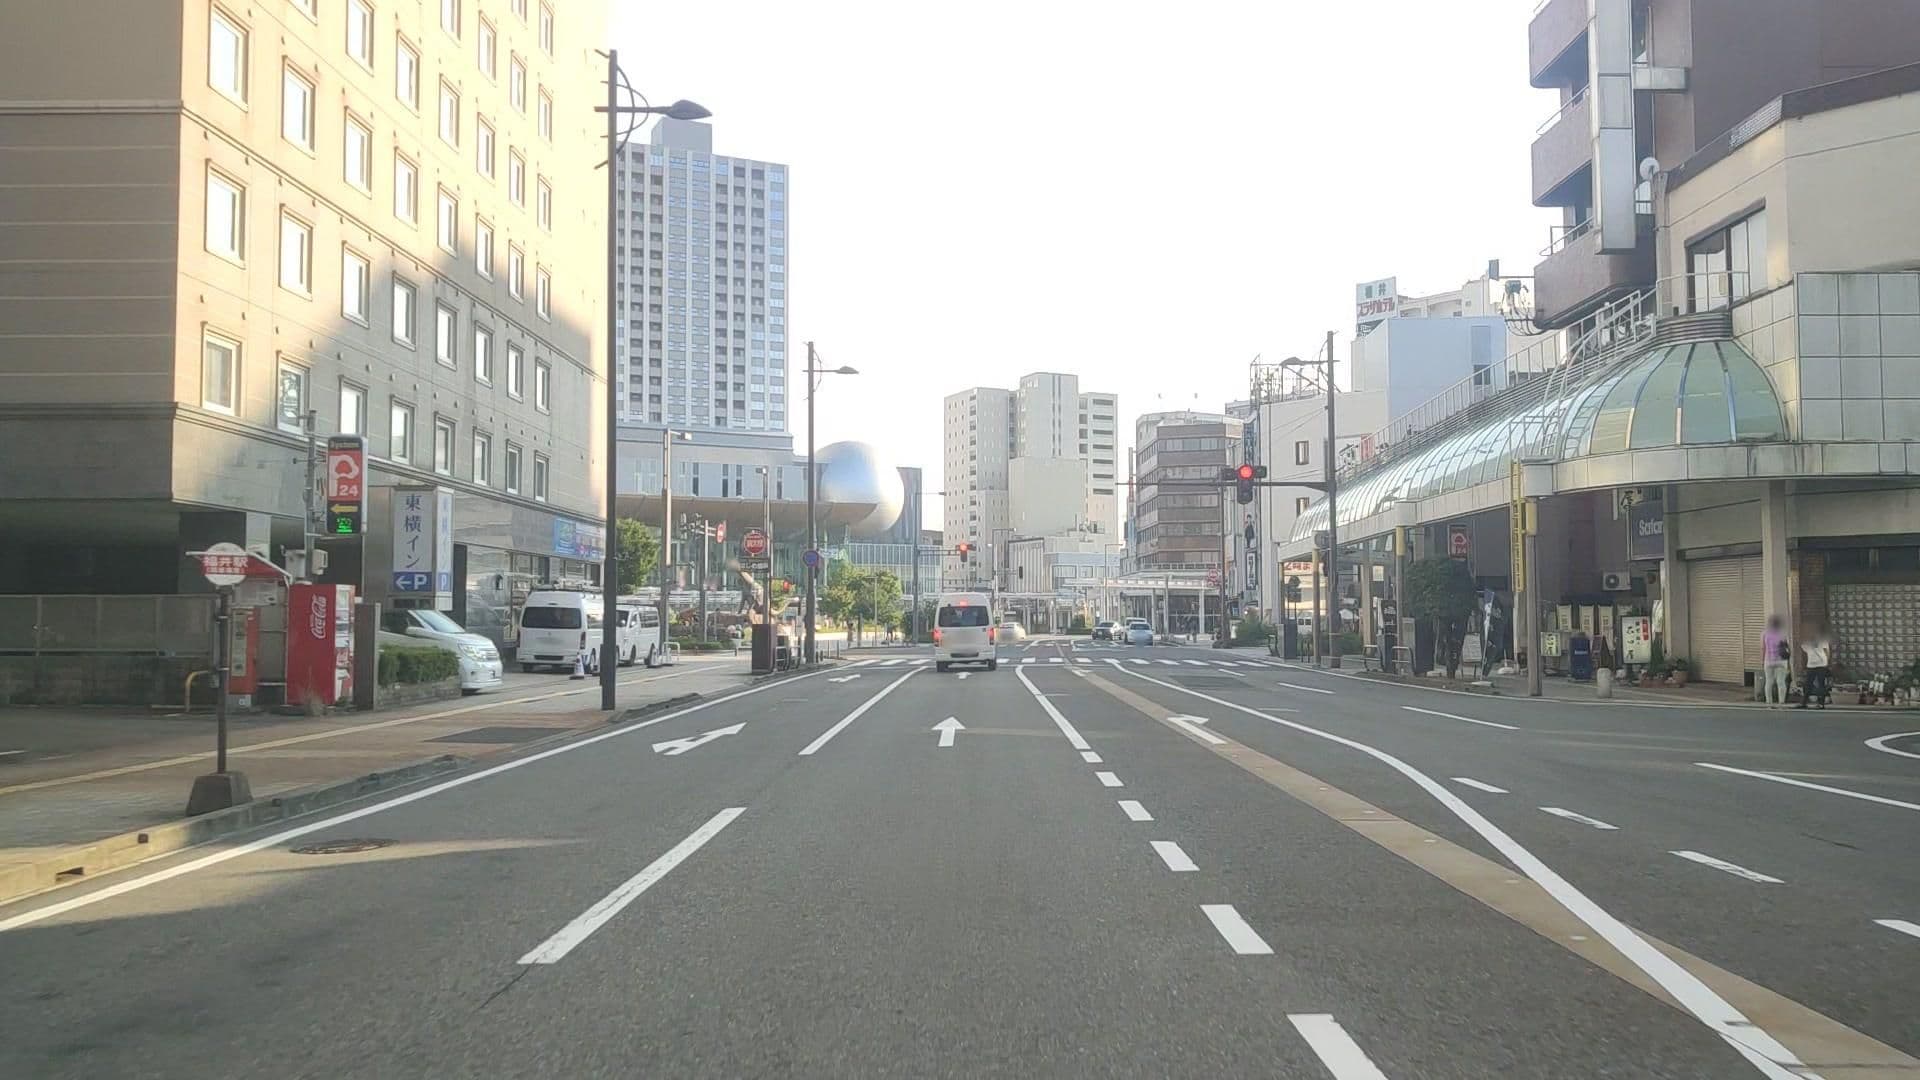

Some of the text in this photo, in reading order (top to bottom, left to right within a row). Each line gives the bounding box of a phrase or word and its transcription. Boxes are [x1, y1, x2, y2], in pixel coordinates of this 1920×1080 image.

[339, 484, 359, 496] 24
[405, 494, 421, 568] 東横イン
[413, 574, 428, 590] P
